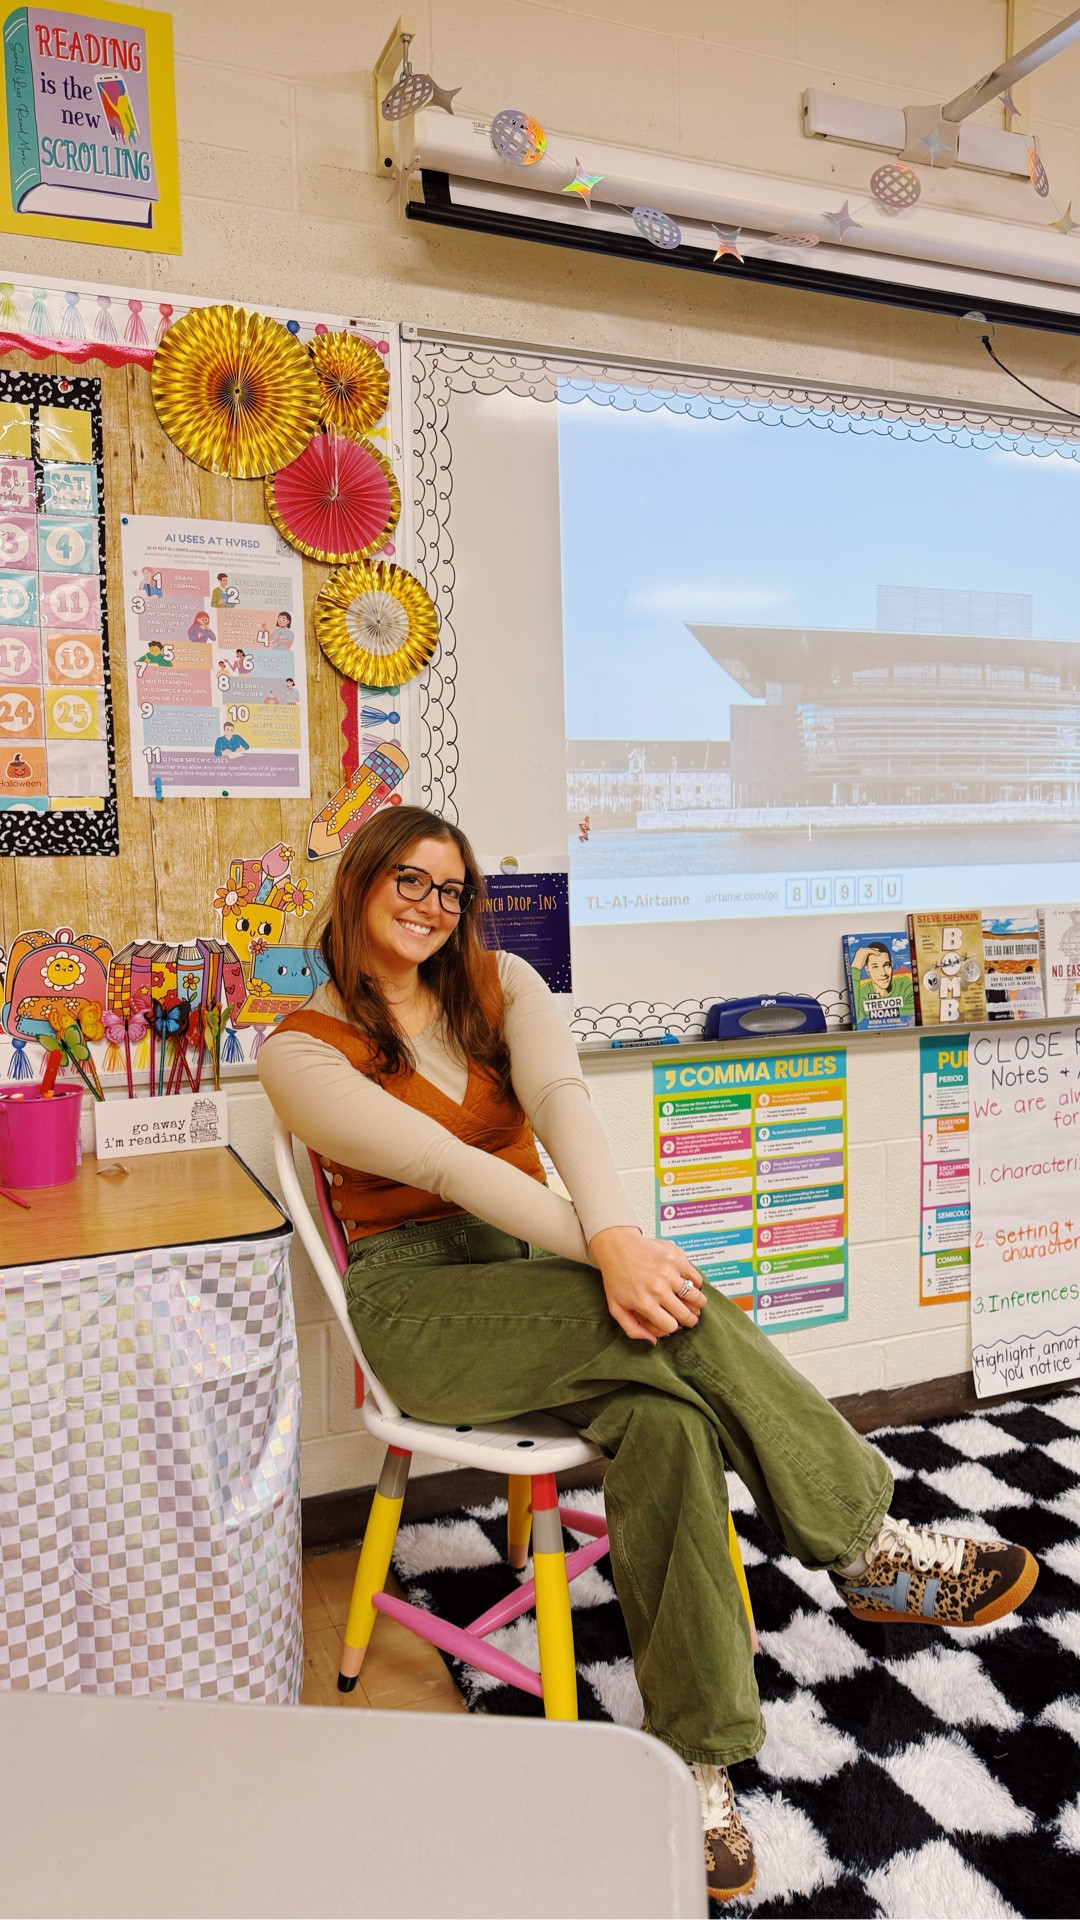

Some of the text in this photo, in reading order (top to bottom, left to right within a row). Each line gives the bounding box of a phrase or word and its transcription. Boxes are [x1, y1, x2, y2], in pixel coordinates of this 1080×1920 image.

[35, 25, 142, 72] READING
[9, 42, 25, 75] Scroll
[41, 72, 93, 101] is the
[15, 103, 29, 134] Read
[61, 107, 101, 129] new
[17, 131, 32, 167] More
[41, 136, 152, 181] SCROLLING
[0, 531, 73, 559] 3 4
[165, 533, 260, 549] AI USES AT HVRSD
[152, 572, 162, 590] 1
[57, 590, 83, 613] 11
[226, 586, 240, 604] 2
[132, 596, 146, 614] 3
[257, 630, 270, 647] 4
[0, 645, 89, 672] 17 18
[162, 644, 174, 662] 5
[134, 661, 148, 678] 7
[242, 654, 254, 671] 6
[218, 674, 230, 692] 8
[0, 700, 89, 729] 24 25
[141, 702, 154, 719] 9
[228, 704, 250, 722] 10
[143, 746, 162, 764] 11
[507, 894, 558, 912] DROP-INS
[586, 882, 897, 910] TL-A1-Airtame airtame.com/go 8 U 9 3 U
[917, 912, 978, 924] STEVE SHEINKIN
[1003, 944, 1014, 955] AWAY
[1015, 944, 1038, 955] BROTHERS
[939, 928, 962, 1022] BOMB
[1052, 964, 1063, 978] NO
[865, 998, 902, 1010] TREVOR
[870, 1010, 898, 1019] NOAH
[974, 1031, 1063, 1066] CLOSE
[680, 1056, 836, 1088] COMMA RULES
[939, 1075, 963, 1083] PERIOD
[992, 1064, 1049, 1090] Notes
[974, 1098, 1002, 1119] We
[1014, 1096, 1046, 1114] are
[132, 1118, 187, 1135] go away
[1053, 1111, 1080, 1128] for
[104, 1132, 187, 1149] i'm reading
[978, 1166, 986, 1186] 1.
[974, 1231, 989, 1249] 2.
[995, 1220, 1060, 1246] Setting
[1064, 1219, 1074, 1232] +
[937, 1255, 962, 1264] COMMA
[988, 1284, 1080, 1314] Inferences
[1000, 1354, 1072, 1388] you notice
